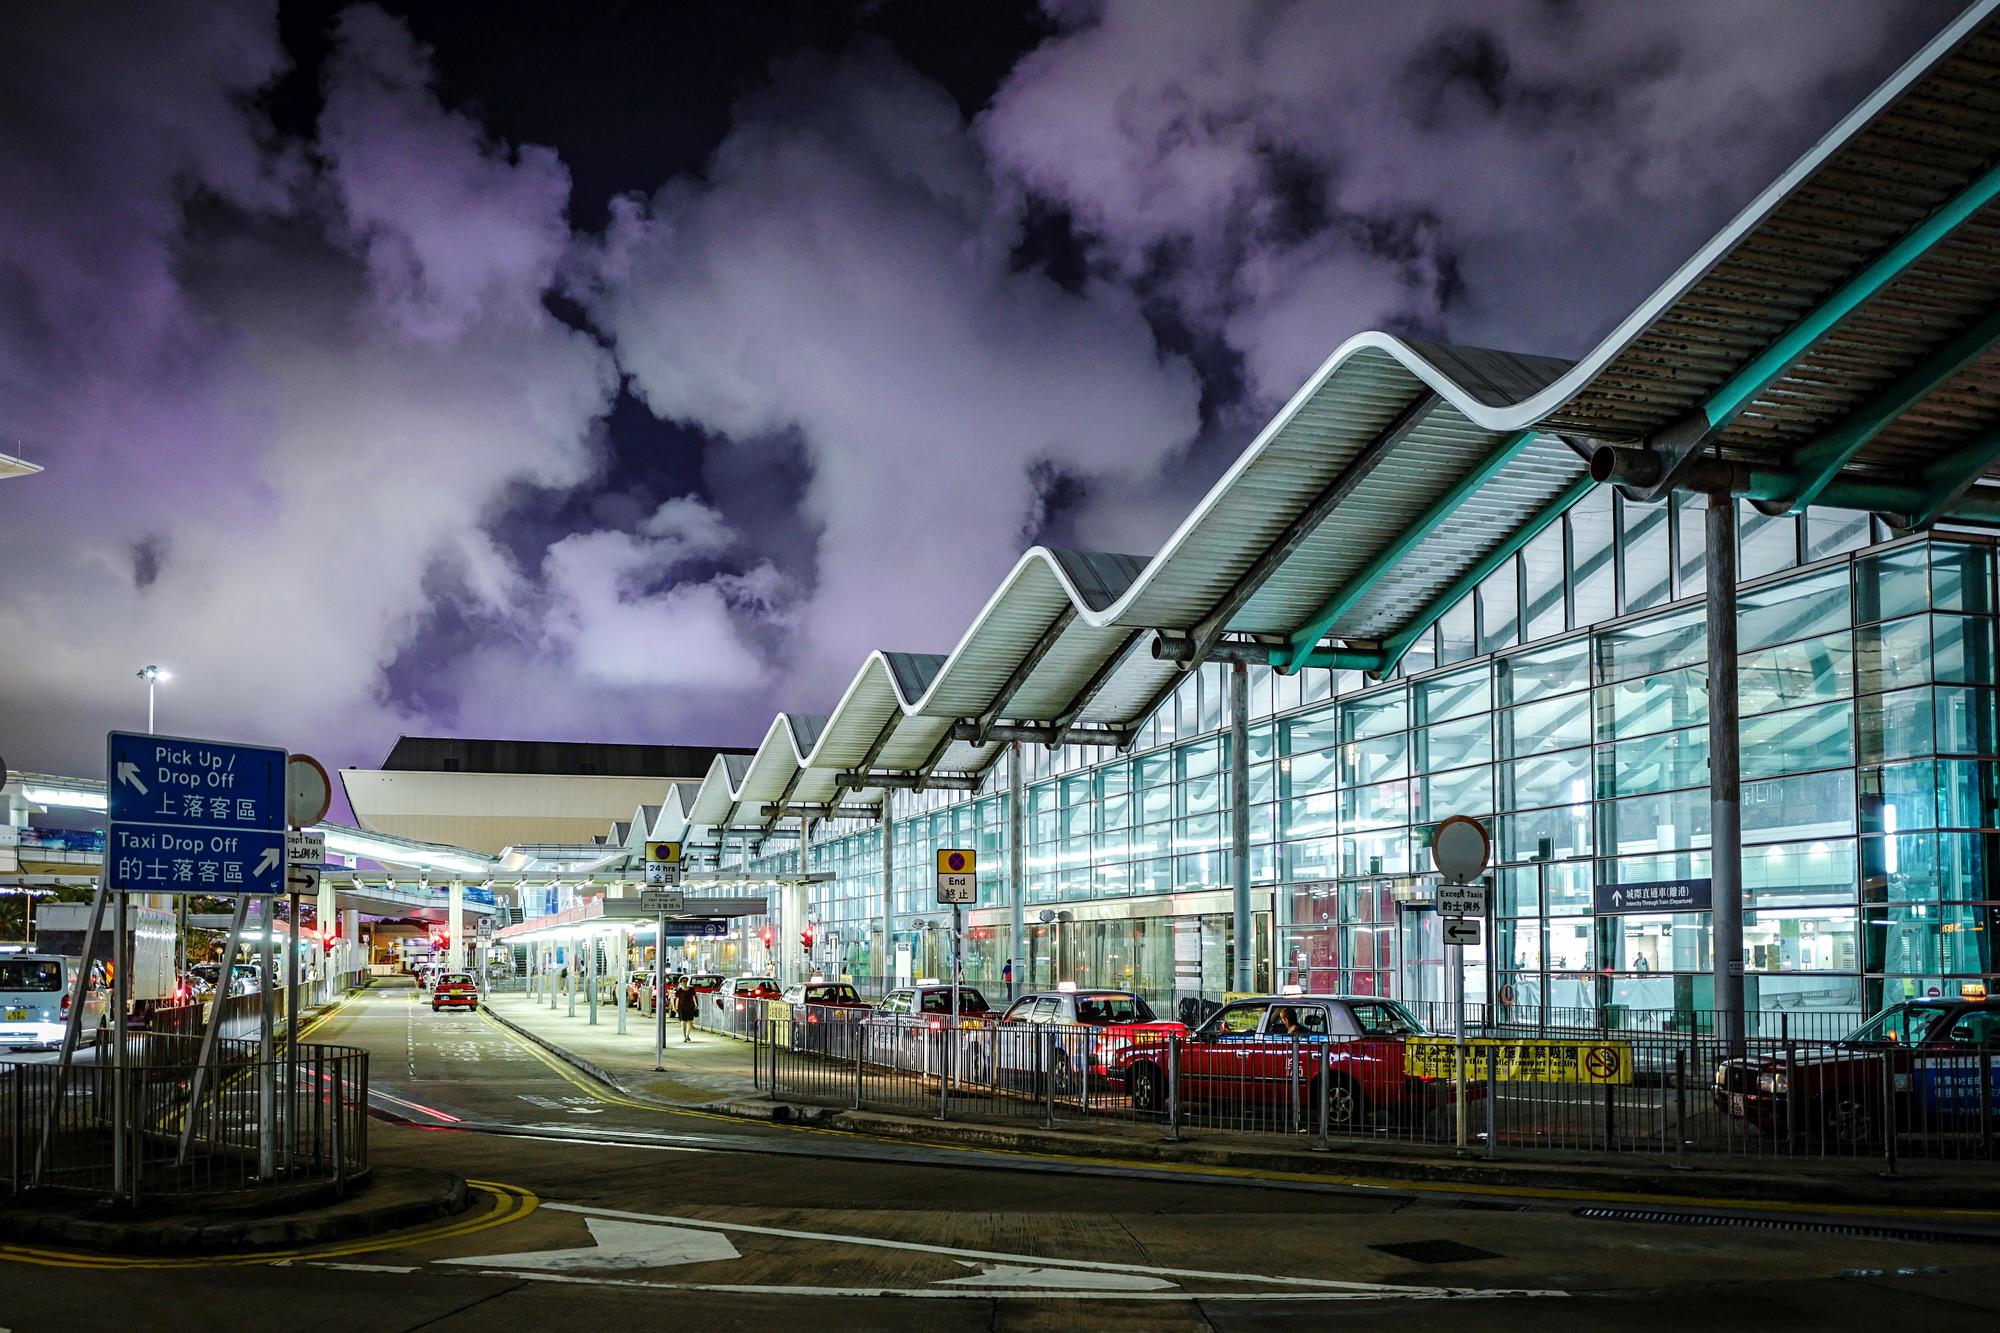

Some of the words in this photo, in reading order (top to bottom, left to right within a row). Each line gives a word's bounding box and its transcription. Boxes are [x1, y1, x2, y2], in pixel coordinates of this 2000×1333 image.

[156, 747, 192, 765] Pick
[199, 751, 222, 771] Up
[227, 754, 236, 771] /
[158, 768, 201, 788] Drop
[207, 772, 235, 788] Off
[155, 792, 257, 821] 上落客區
[118, 831, 156, 849] Taxi
[162, 834, 204, 854] Drop
[210, 837, 238, 853] Off
[288, 836, 303, 844] cept
[304, 836, 322, 845] Taxis
[288, 847, 320, 859] 士例外
[119, 856, 244, 884] 的士落客區
[653, 874, 673, 884] 全日
[949, 877, 966, 886] End
[945, 888, 969, 900] 終止
[1440, 889, 1465, 899] Except
[1467, 890, 1483, 899] Taxis
[1442, 900, 1481, 912] 的士例外
[1641, 899, 1659, 907] Through
